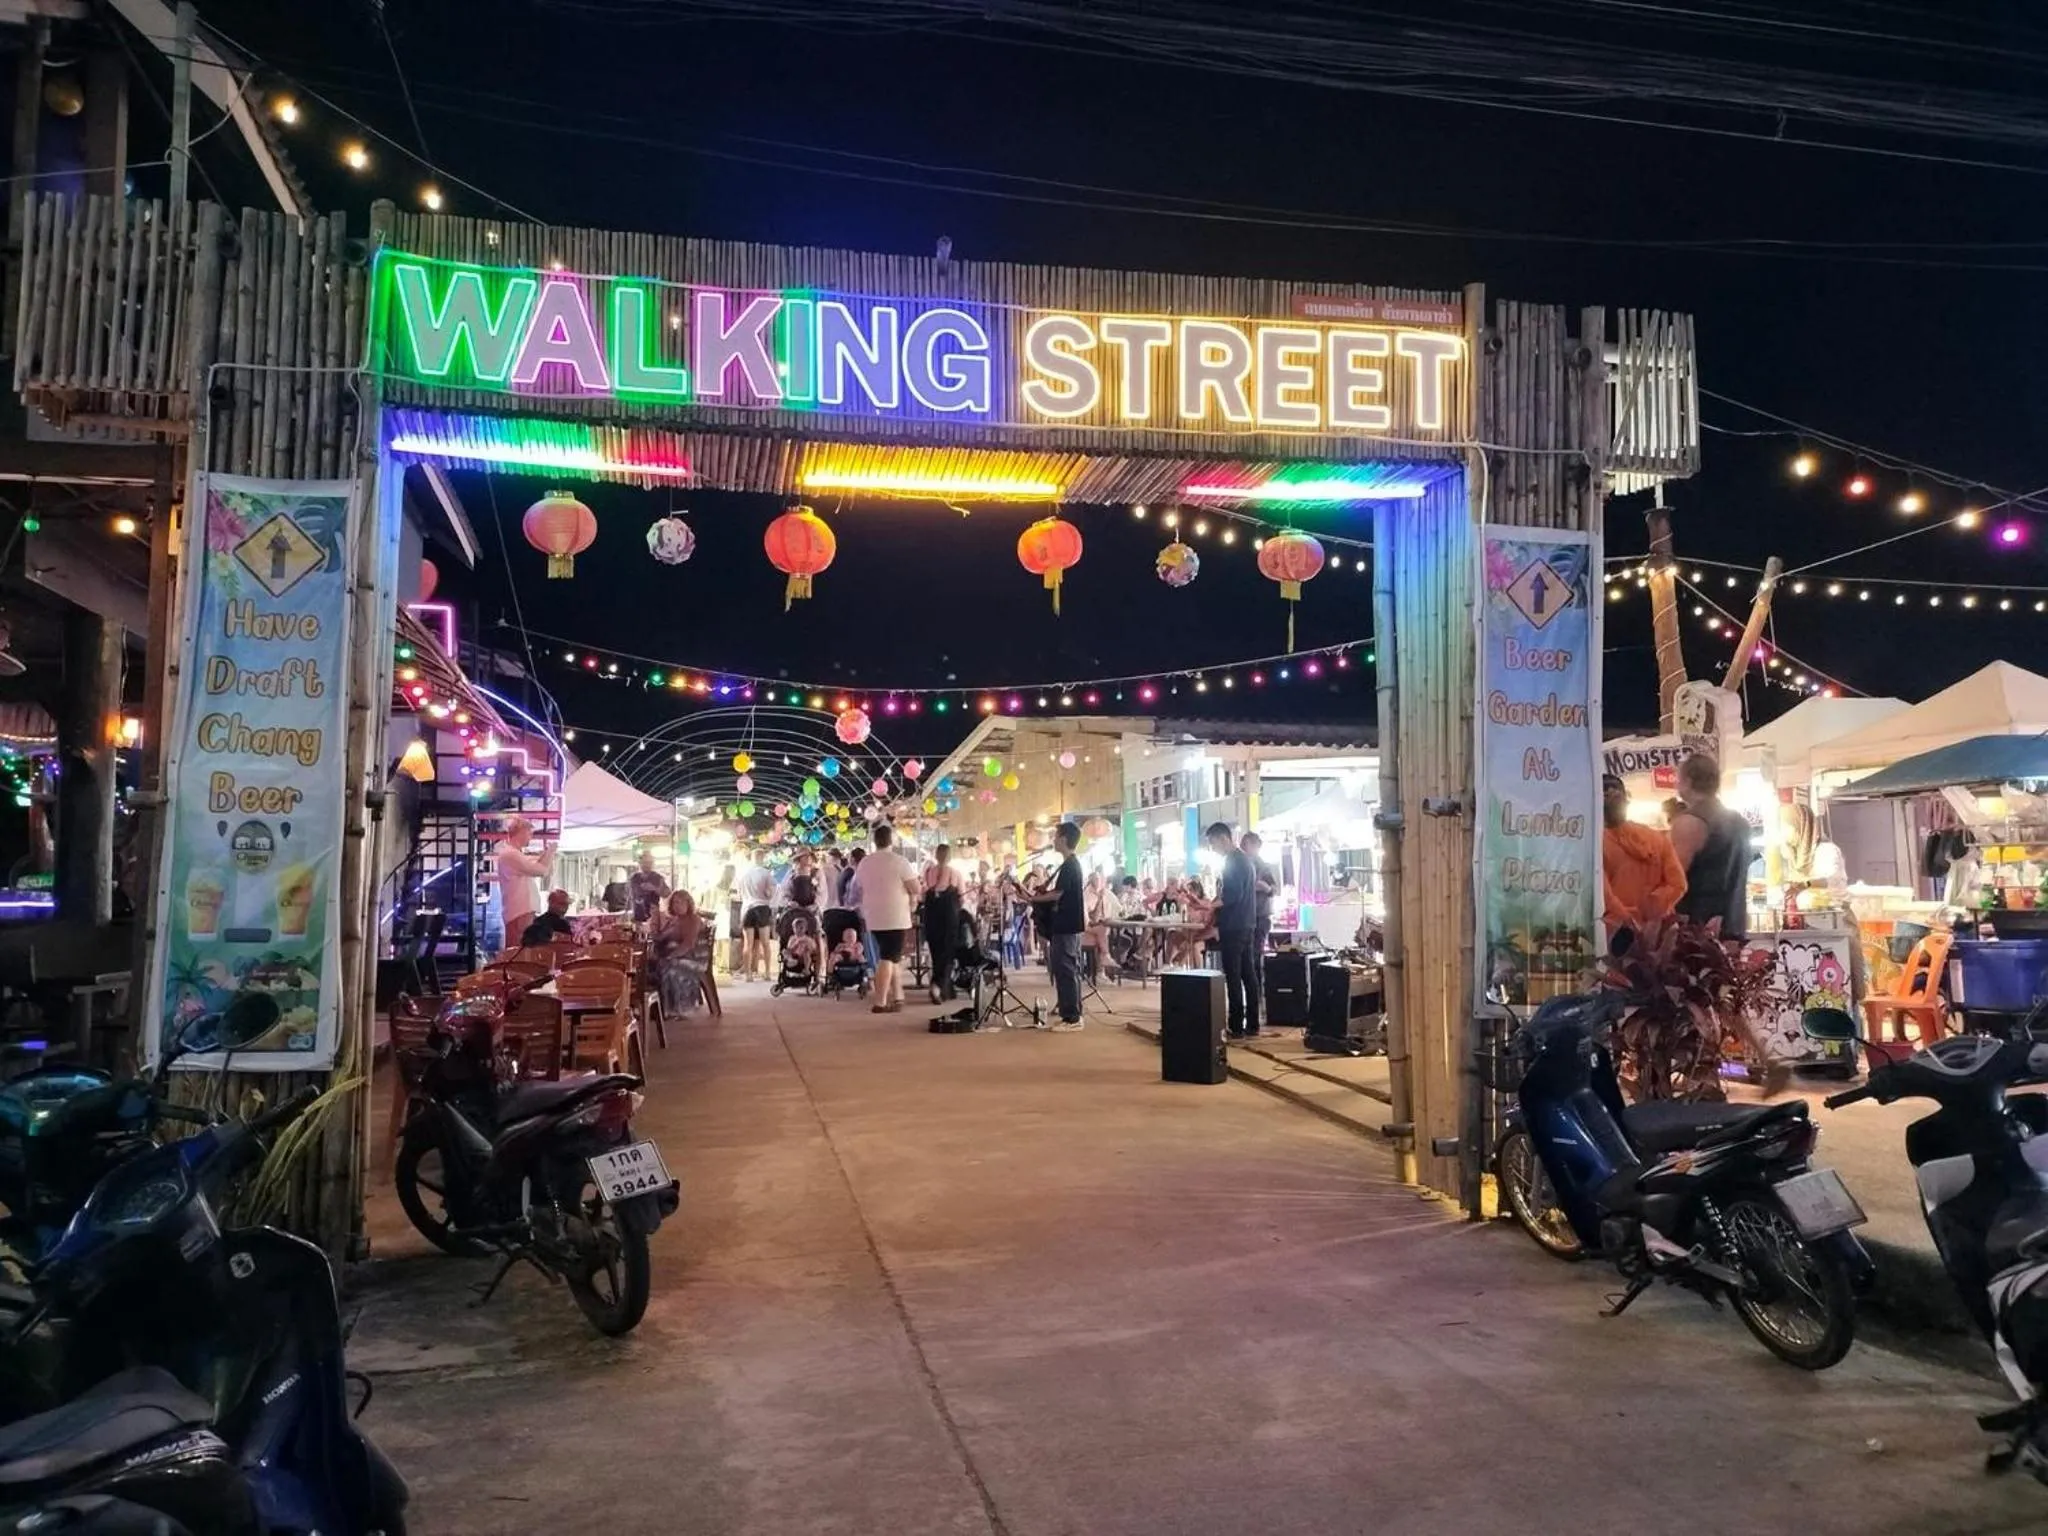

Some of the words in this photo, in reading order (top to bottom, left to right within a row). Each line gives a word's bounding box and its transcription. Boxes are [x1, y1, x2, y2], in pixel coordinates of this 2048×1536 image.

[393, 264, 991, 413] WALKING
[1022, 316, 1462, 429] STREET
[224, 599, 322, 641] Have
[1504, 637, 1572, 673] Beer
[206, 655, 324, 699] Draft
[1488, 690, 1588, 728] Garden
[197, 712, 323, 766] Chang
[1522, 746, 1560, 783] At
[208, 770, 303, 814] Beer
[1502, 800, 1585, 840] Lanta
[1503, 856, 1582, 896] Plaza
[611, 1173, 659, 1197] 3944
